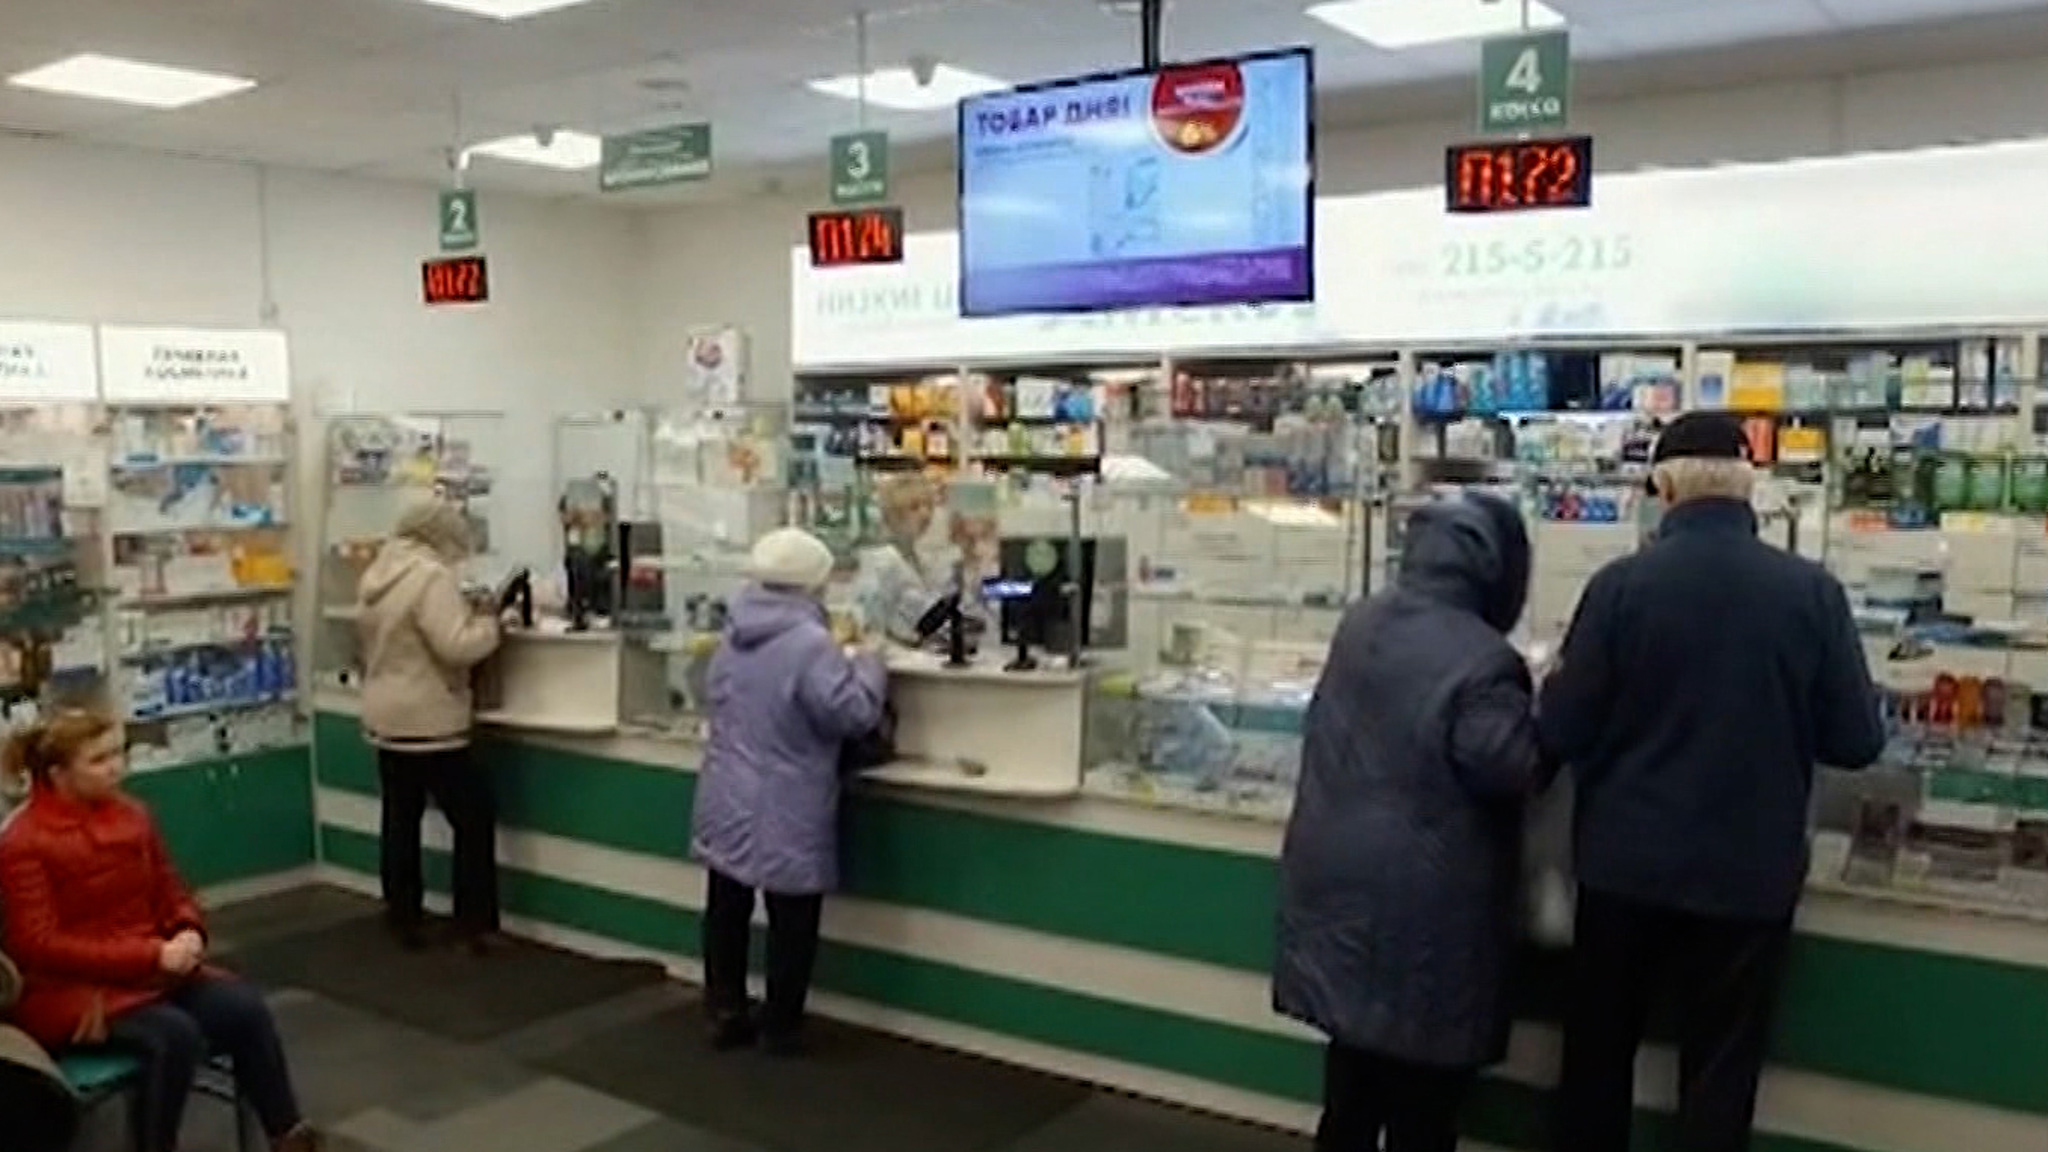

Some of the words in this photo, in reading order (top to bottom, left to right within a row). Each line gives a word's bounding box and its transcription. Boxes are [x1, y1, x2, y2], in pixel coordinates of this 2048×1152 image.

[1504, 48, 1542, 93] 4
[847, 141, 870, 180] 3
[450, 199, 467, 230] 2
[1442, 234, 1632, 276] 215-5-215
